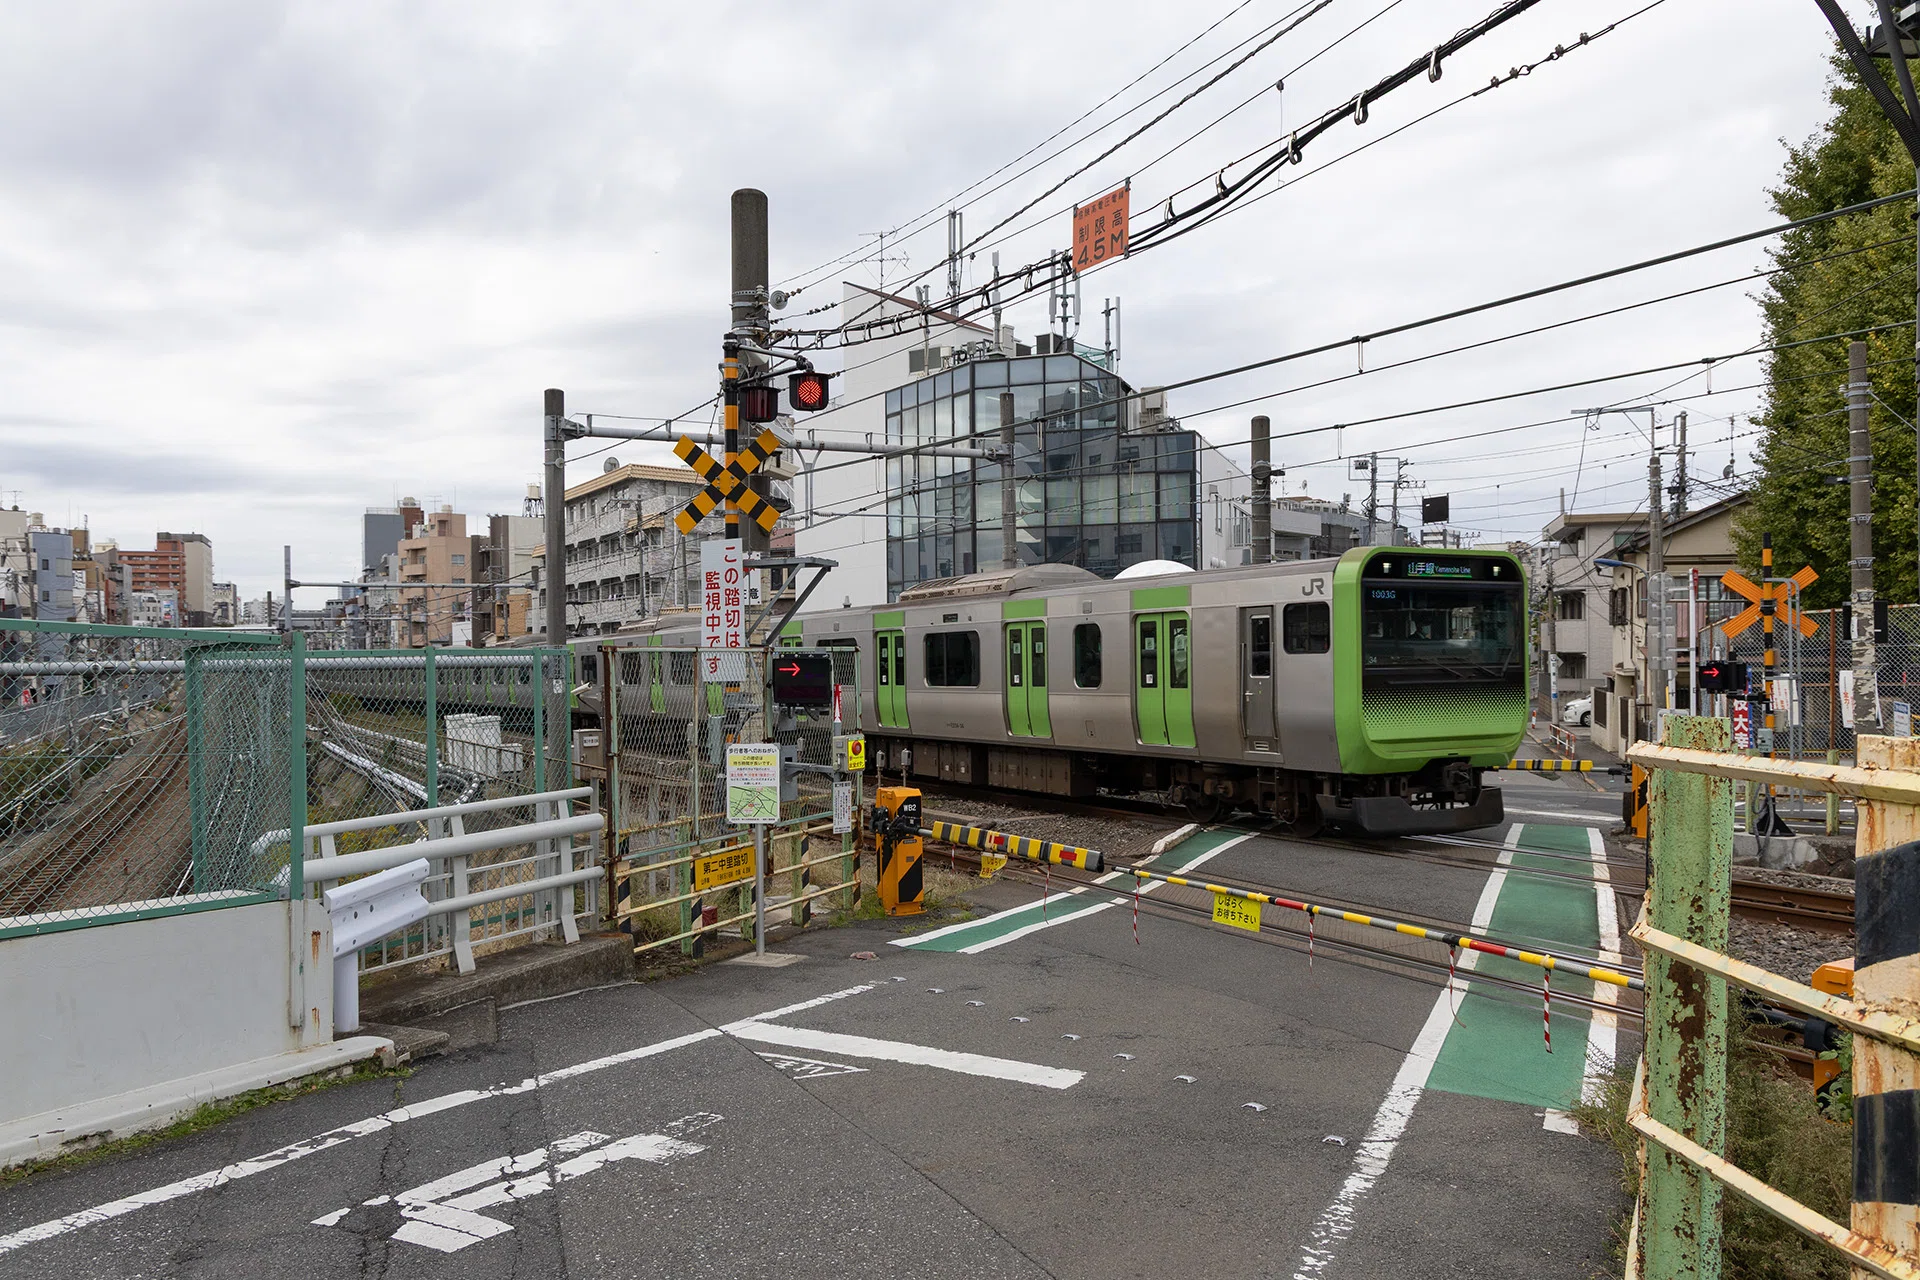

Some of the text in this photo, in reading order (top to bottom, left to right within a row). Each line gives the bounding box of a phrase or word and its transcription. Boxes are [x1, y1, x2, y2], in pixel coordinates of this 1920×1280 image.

[1407, 562, 1471, 575] 山手線 Yamanote Line
[1302, 578, 1325, 597] JR
[724, 545, 741, 649] この踏切は
[705, 570, 721, 675] 監視中です
[903, 804, 917, 812] WB2
[703, 852, 749, 875] 第二中里踏切
[1217, 896, 1244, 910] しばらく
[1216, 907, 1257, 924] お待ち下さい
